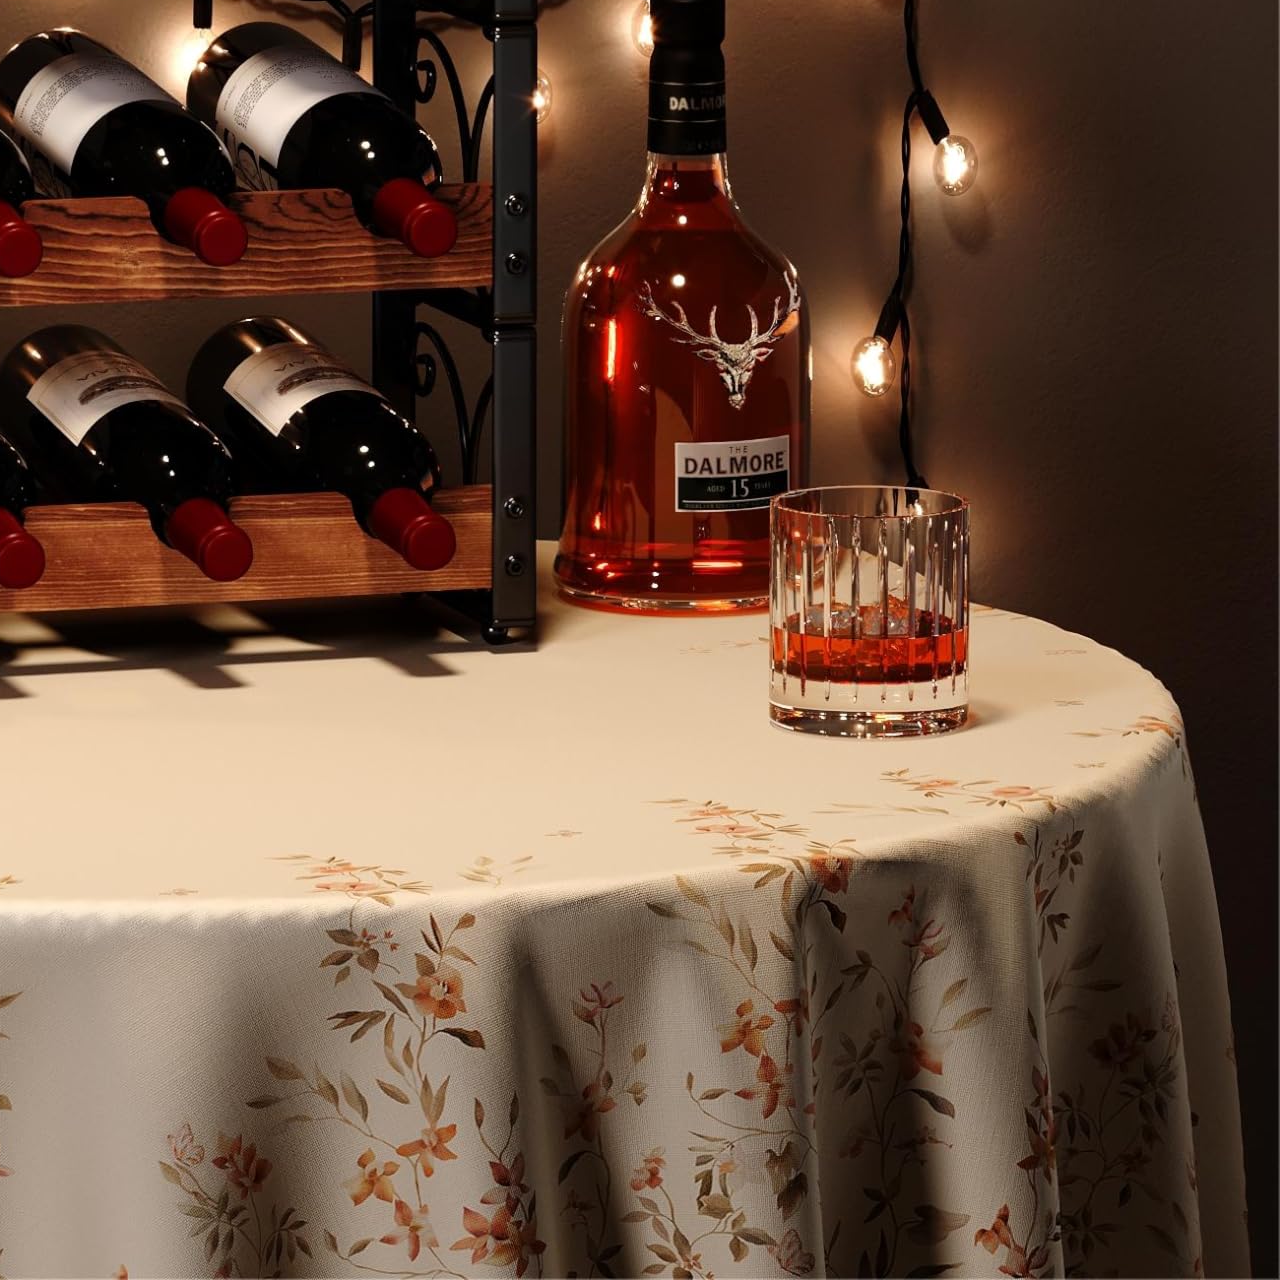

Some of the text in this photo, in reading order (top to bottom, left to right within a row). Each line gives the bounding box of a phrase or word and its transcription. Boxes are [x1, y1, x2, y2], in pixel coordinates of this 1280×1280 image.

[729, 445, 749, 454] THE
[684, 451, 785, 474] DALMORE
[730, 478, 750, 498] 15
